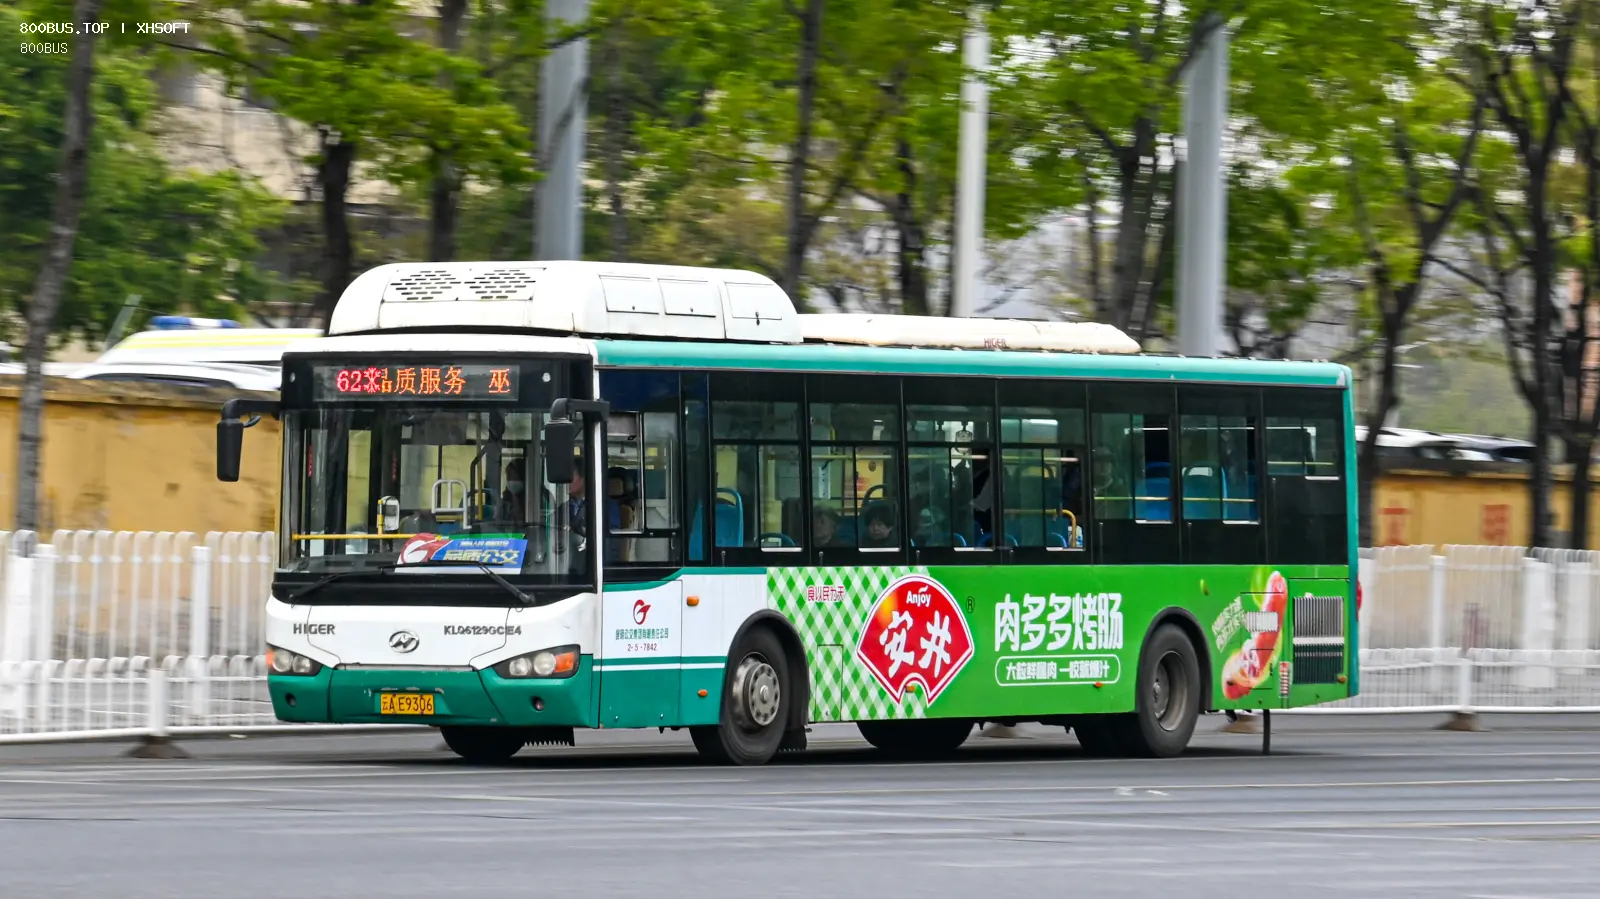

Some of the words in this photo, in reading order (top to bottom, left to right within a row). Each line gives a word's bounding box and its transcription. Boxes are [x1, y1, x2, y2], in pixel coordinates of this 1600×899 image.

[337, 370, 362, 392] 62
[906, 587, 931, 607] Anjoy
[293, 624, 335, 635] HIGER
[995, 593, 1123, 652] 肉多多烤肠
[879, 610, 952, 679] 安井
